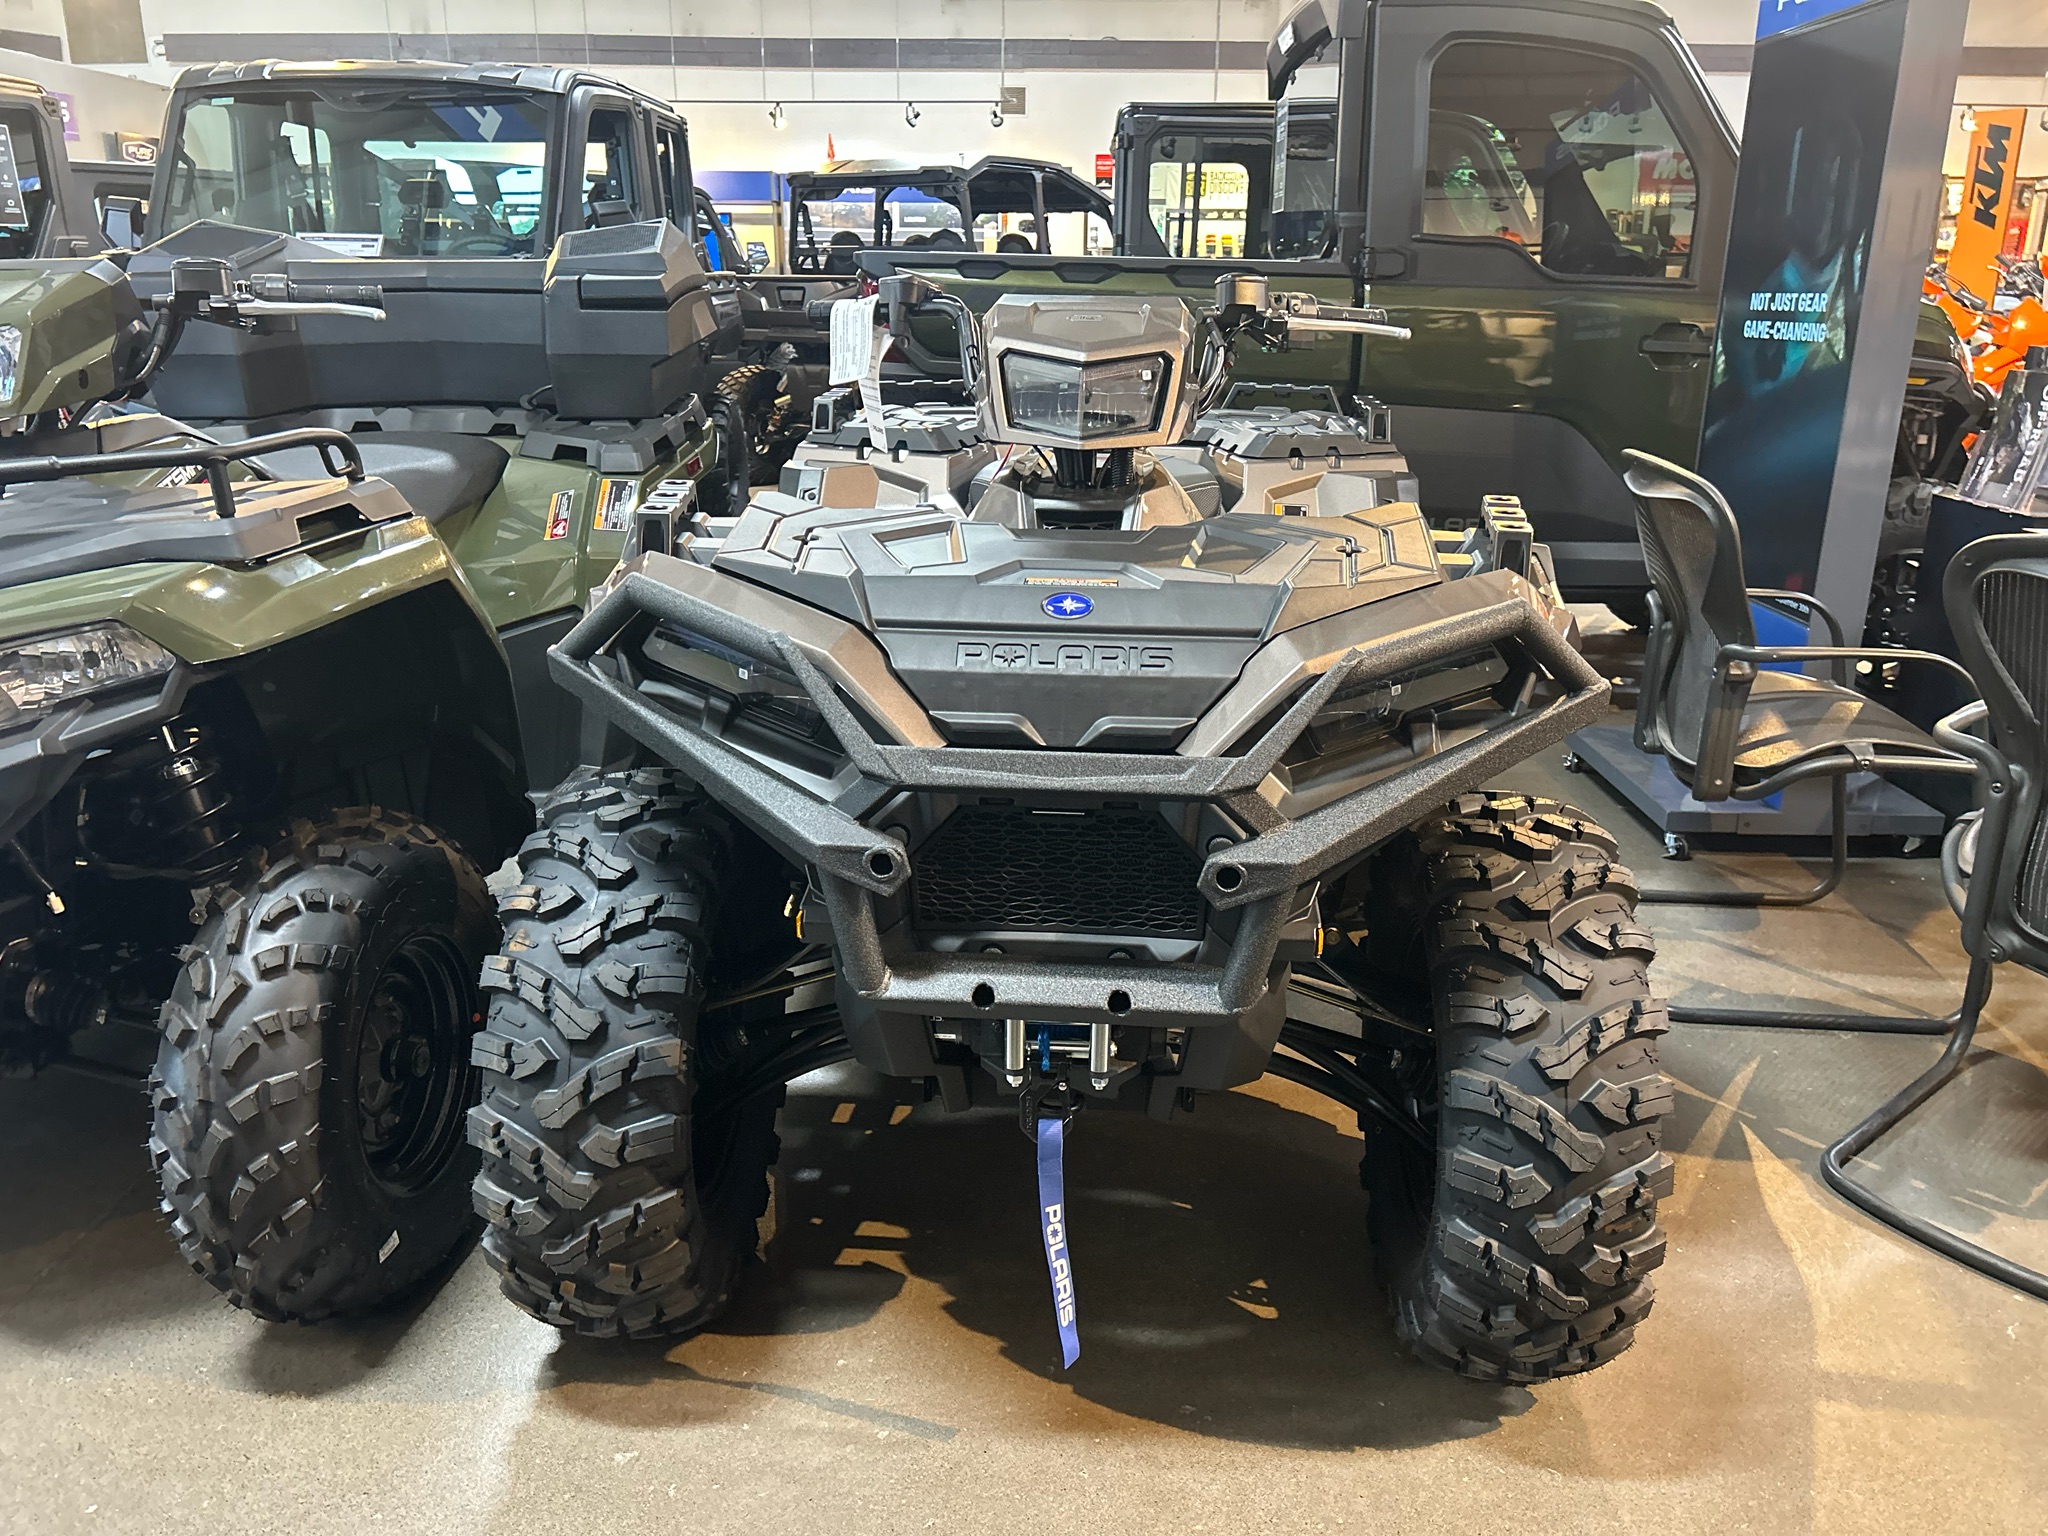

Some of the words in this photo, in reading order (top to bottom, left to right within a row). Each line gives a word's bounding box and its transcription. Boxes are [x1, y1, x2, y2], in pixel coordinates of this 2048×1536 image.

[1653, 157, 1694, 180] MO
[1969, 123, 2012, 230] KTM
[1210, 182, 1243, 194] DISCOVE
[1749, 292, 1772, 311] NOT
[1770, 292, 1799, 312] JUST
[1798, 292, 1829, 313] GEAR
[1743, 319, 1829, 343] GAME-CHANGING
[955, 641, 1174, 673] POLARIS
[1045, 1203, 1074, 1328] POLARIS
